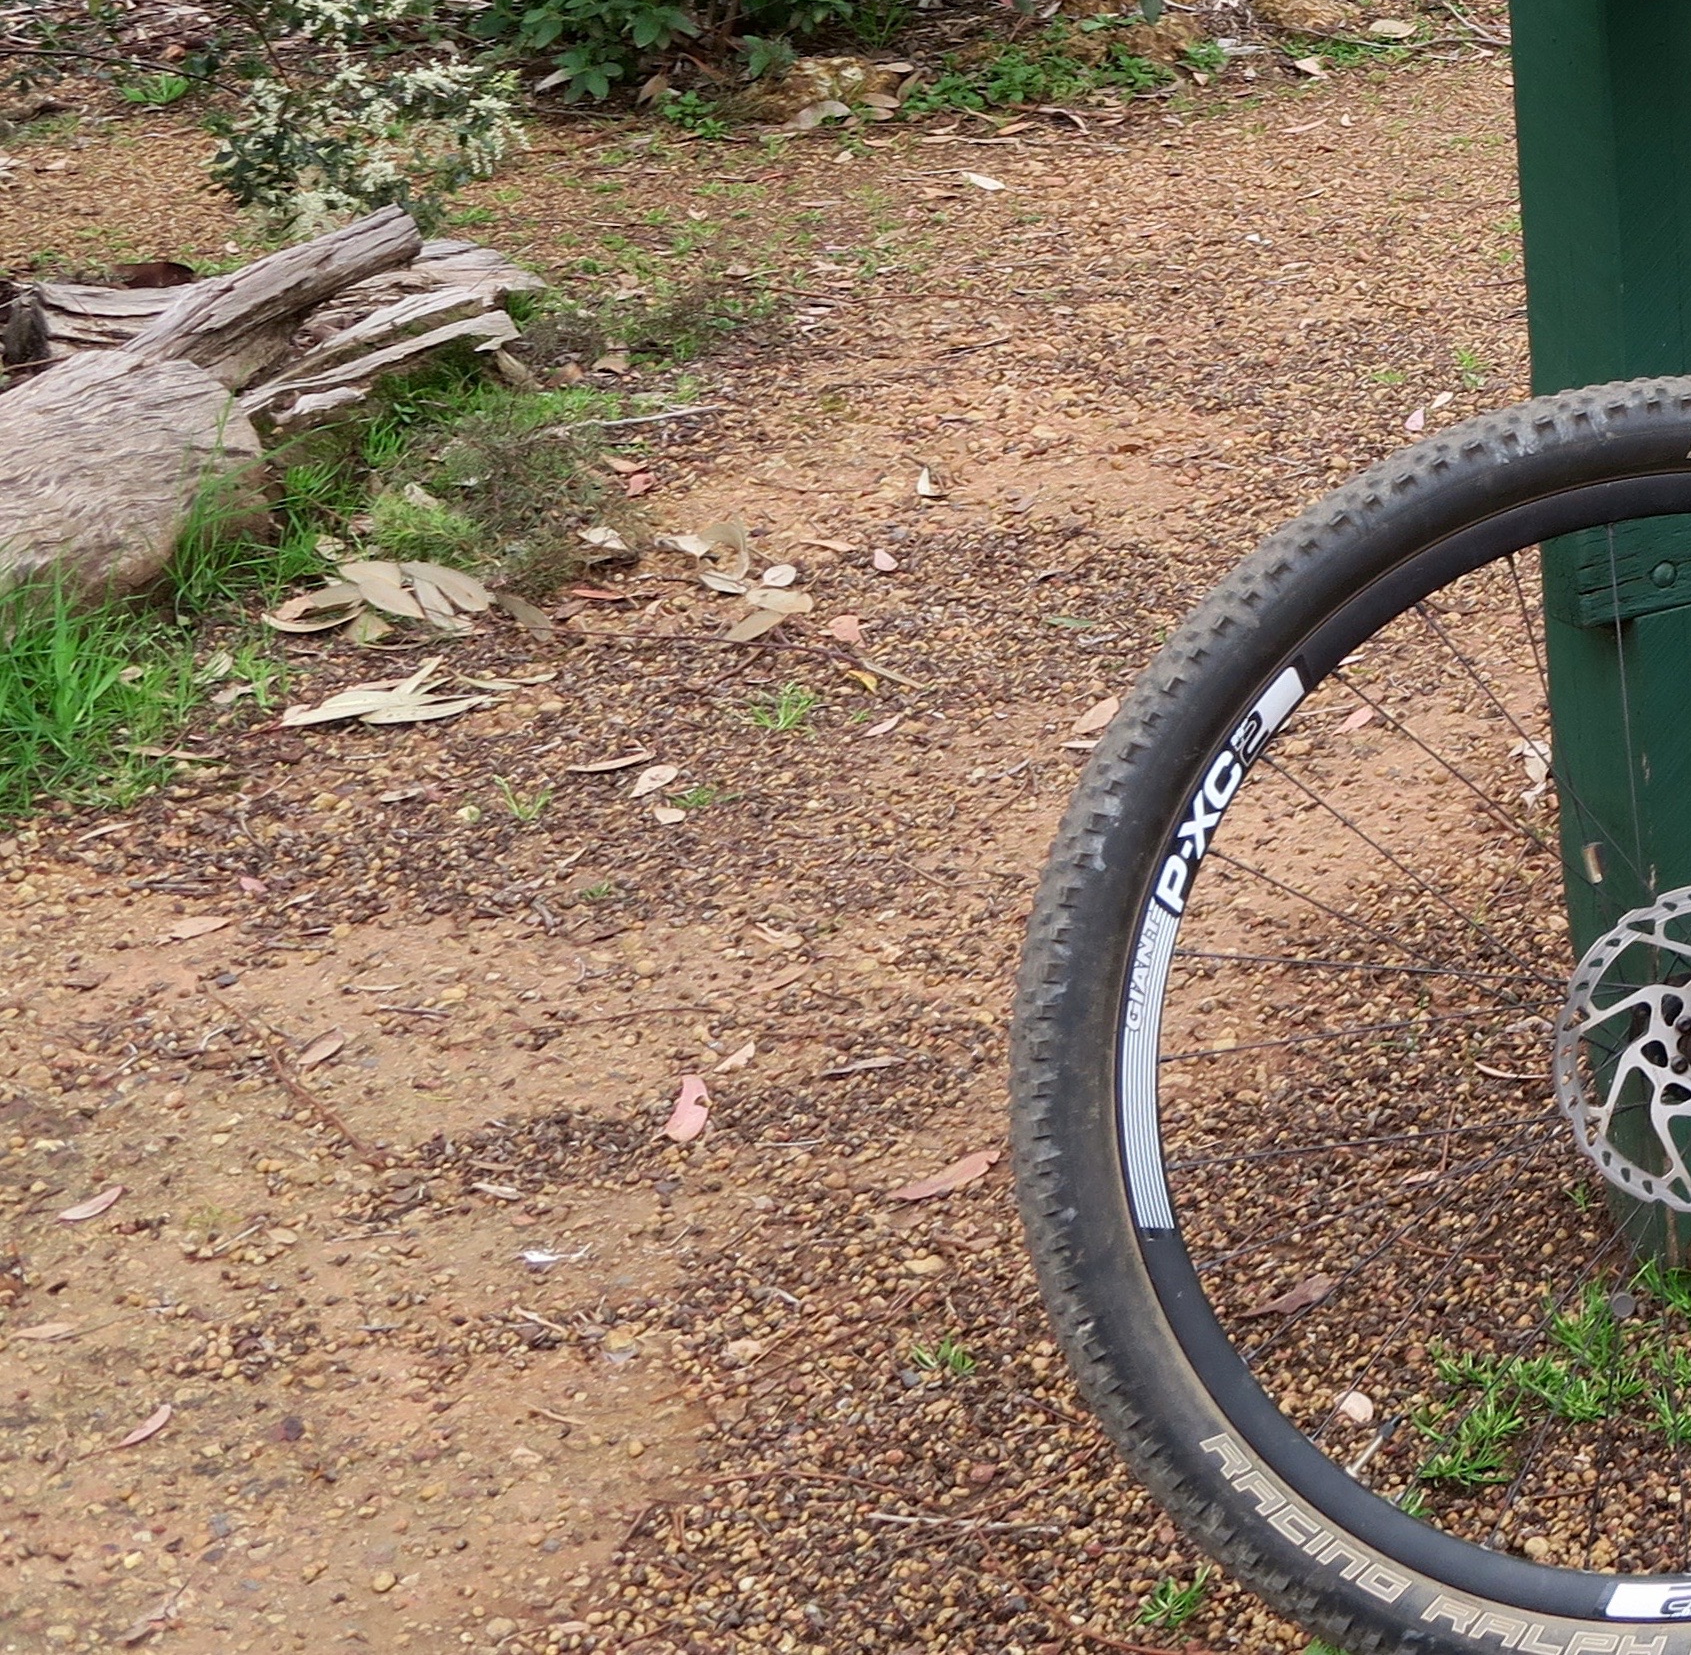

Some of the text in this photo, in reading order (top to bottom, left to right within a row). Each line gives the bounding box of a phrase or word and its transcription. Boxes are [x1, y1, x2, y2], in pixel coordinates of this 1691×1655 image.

[1156, 711, 1269, 913] P-XC2
[1126, 897, 1163, 1031] GIANT
[1200, 1433, 1668, 1655] RACING RALPH
